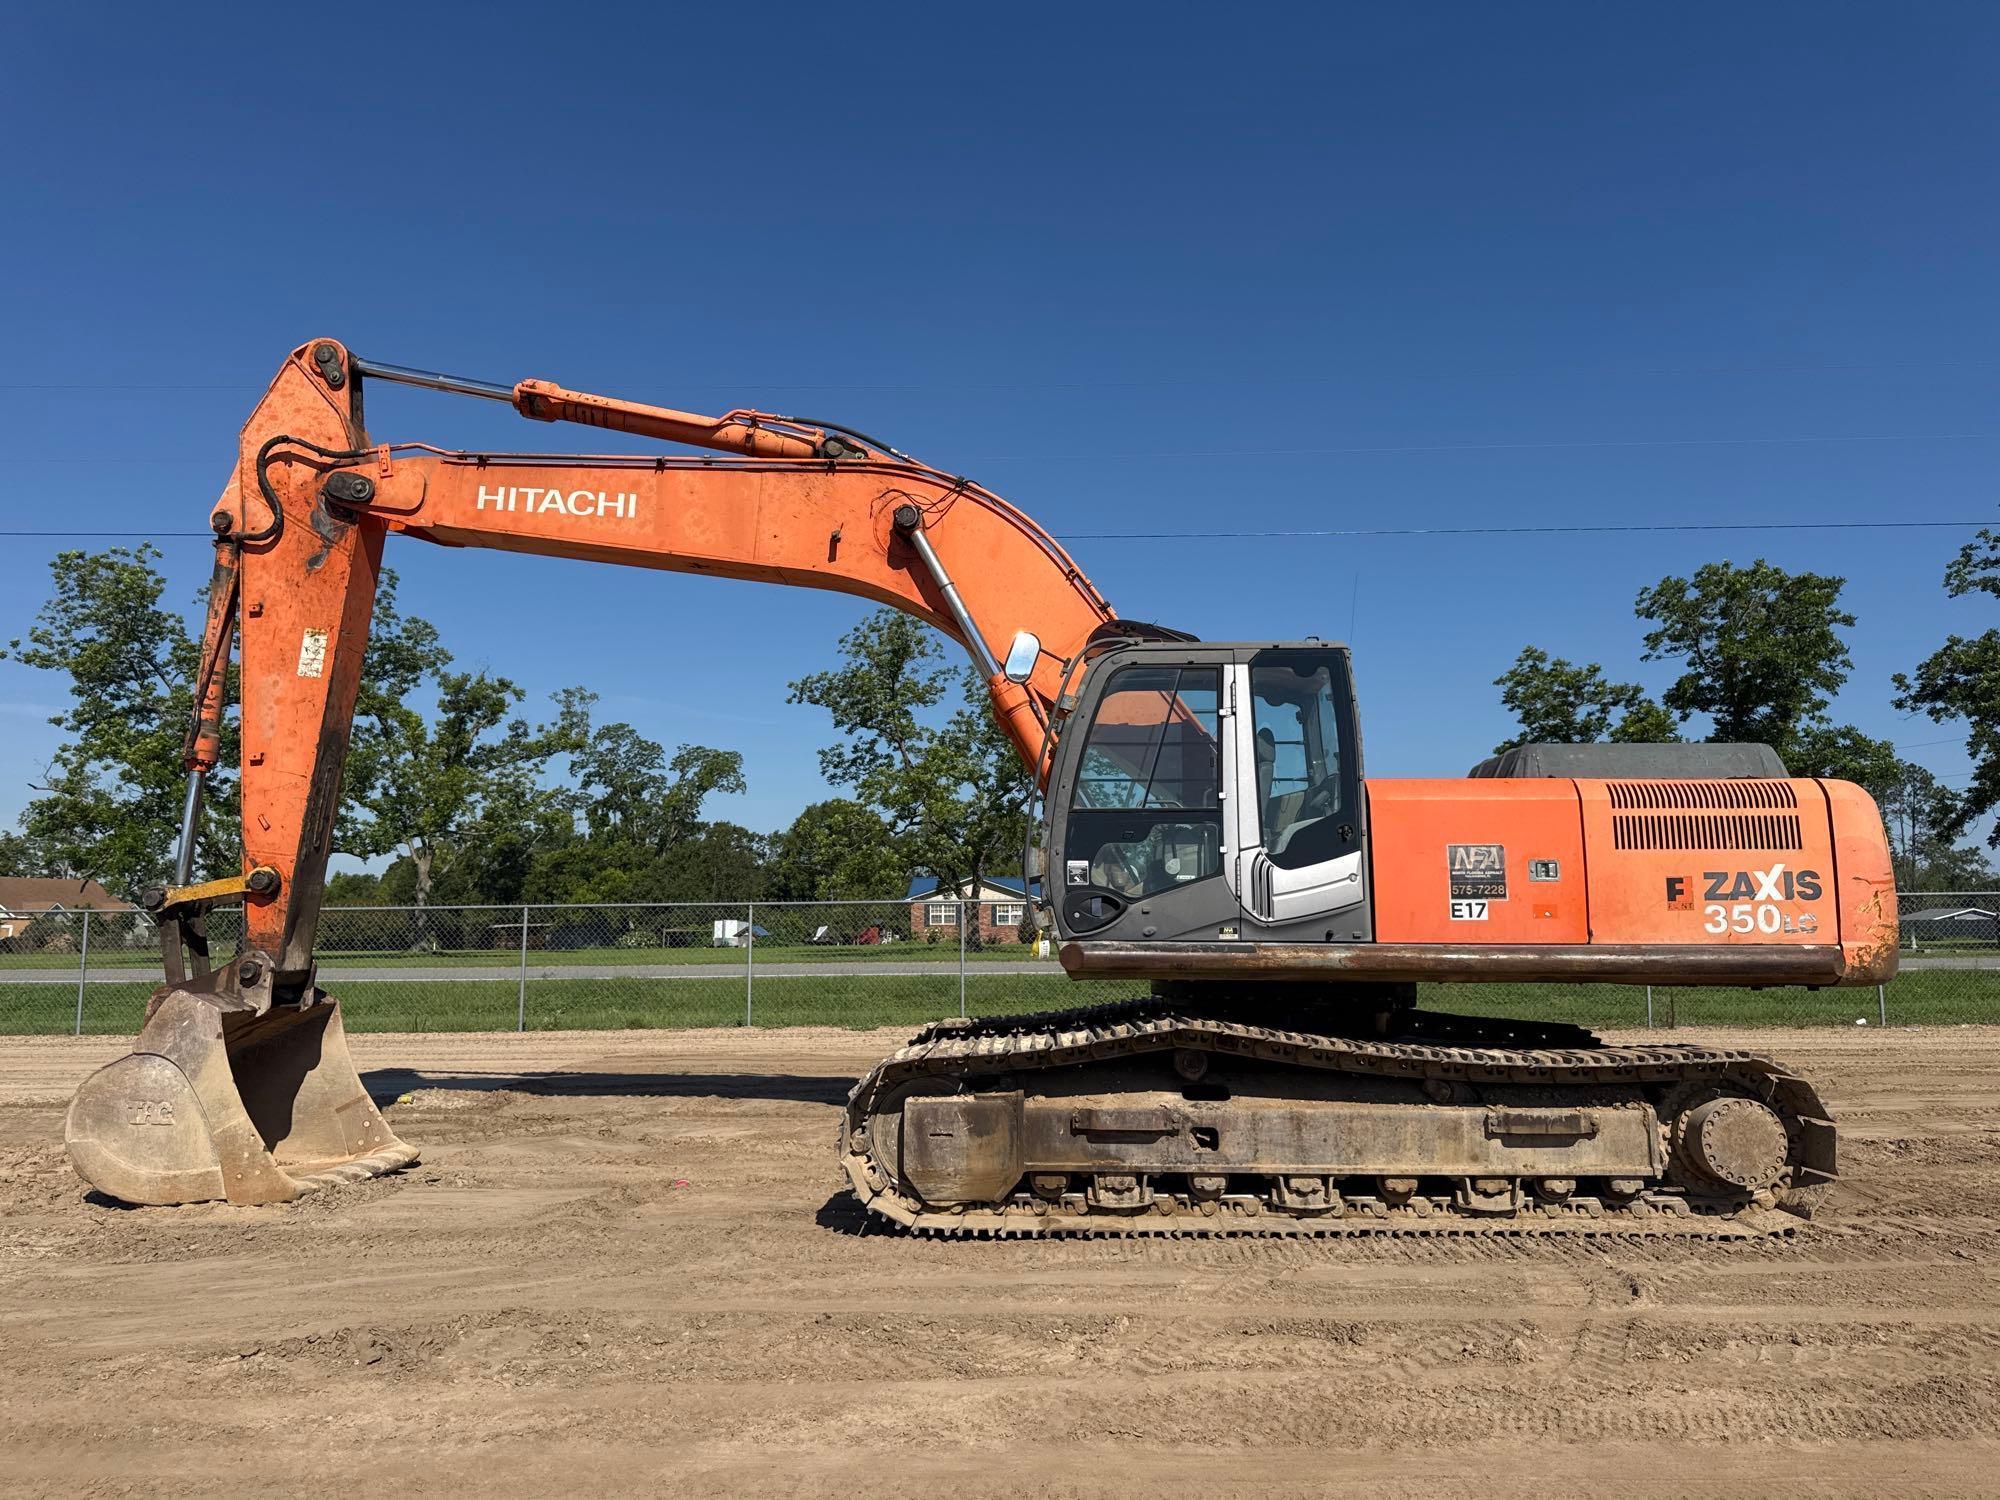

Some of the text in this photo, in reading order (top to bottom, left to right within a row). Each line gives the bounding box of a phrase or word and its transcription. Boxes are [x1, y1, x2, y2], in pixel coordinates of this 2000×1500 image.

[477, 485, 637, 518] HITACHI
[1454, 846, 1501, 869] NFA
[1452, 885, 1505, 895] 575-7228
[1703, 864, 1822, 901] ZAXIS
[1451, 903, 1486, 918] E17
